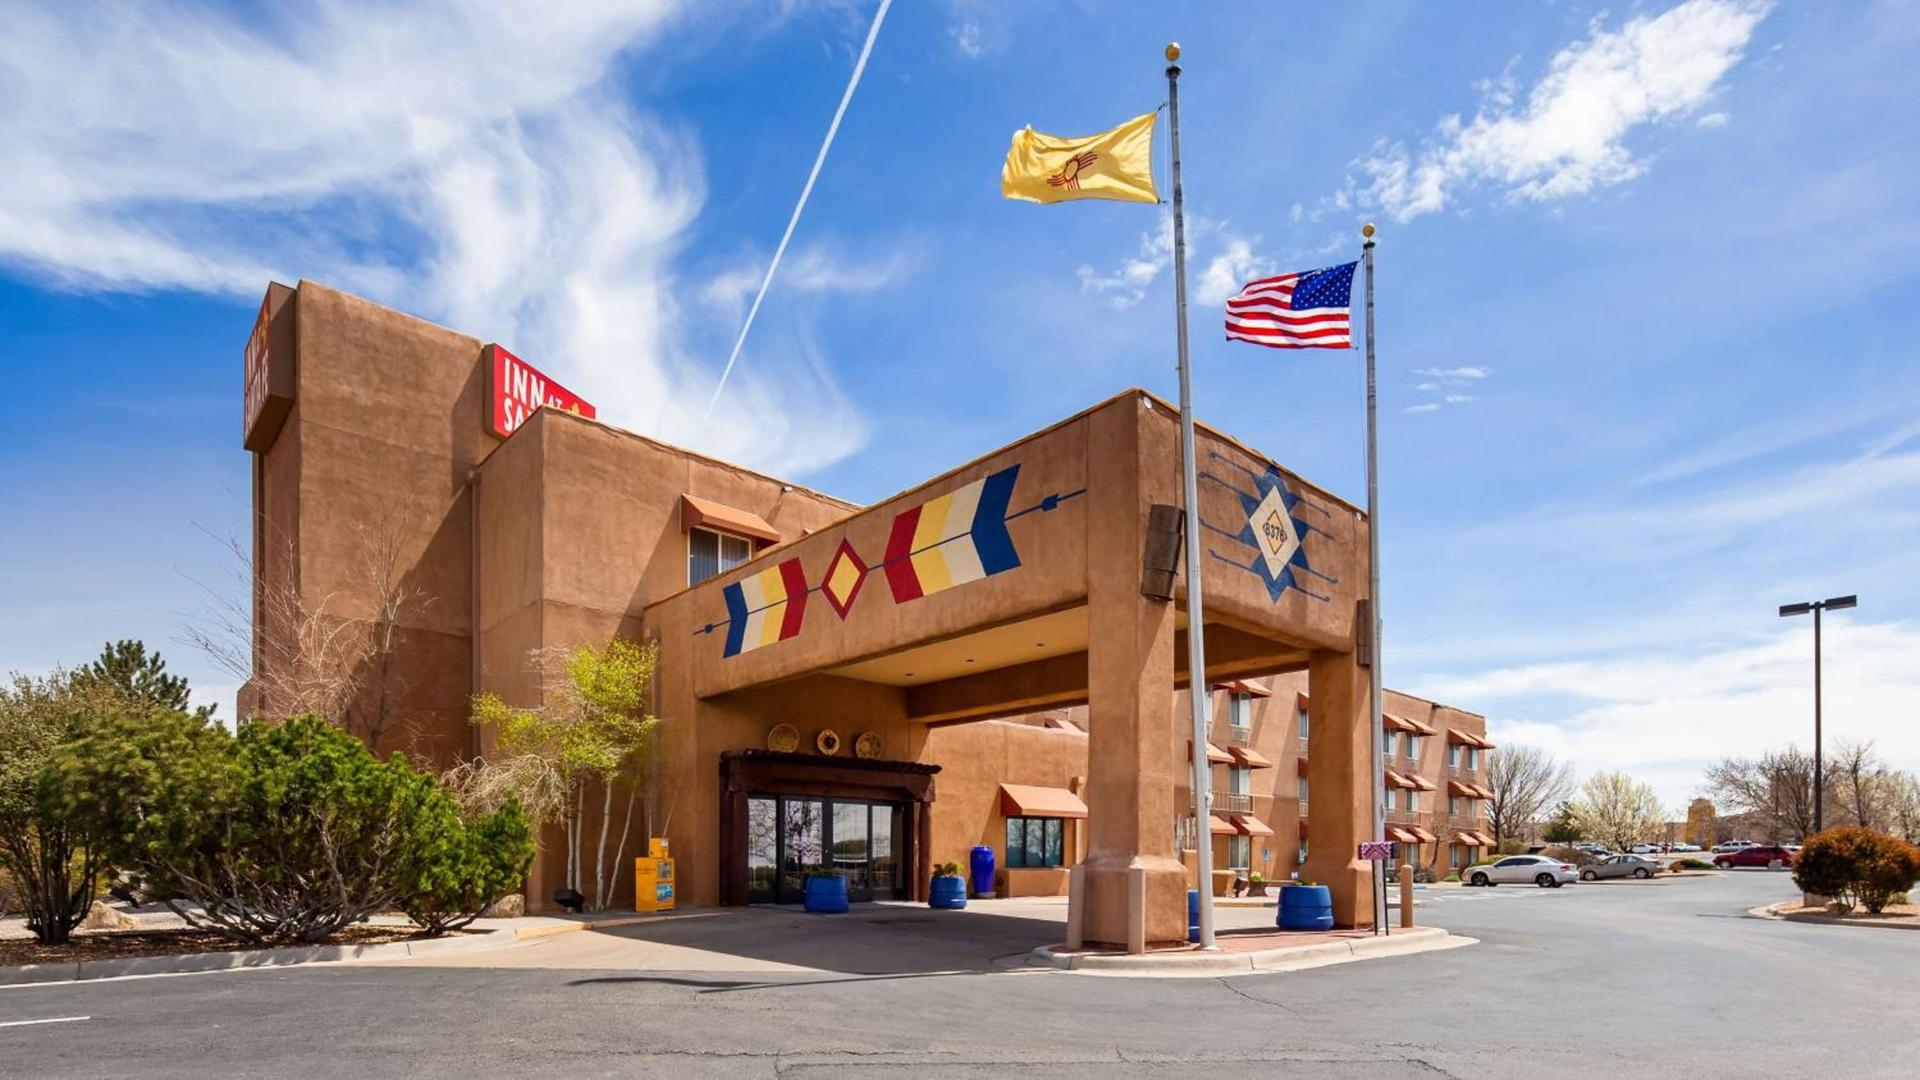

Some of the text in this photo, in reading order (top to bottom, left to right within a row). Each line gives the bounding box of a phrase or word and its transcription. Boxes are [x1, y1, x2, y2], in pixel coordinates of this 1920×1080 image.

[504, 357, 563, 410] INN AT
[503, 397, 532, 433] SA
